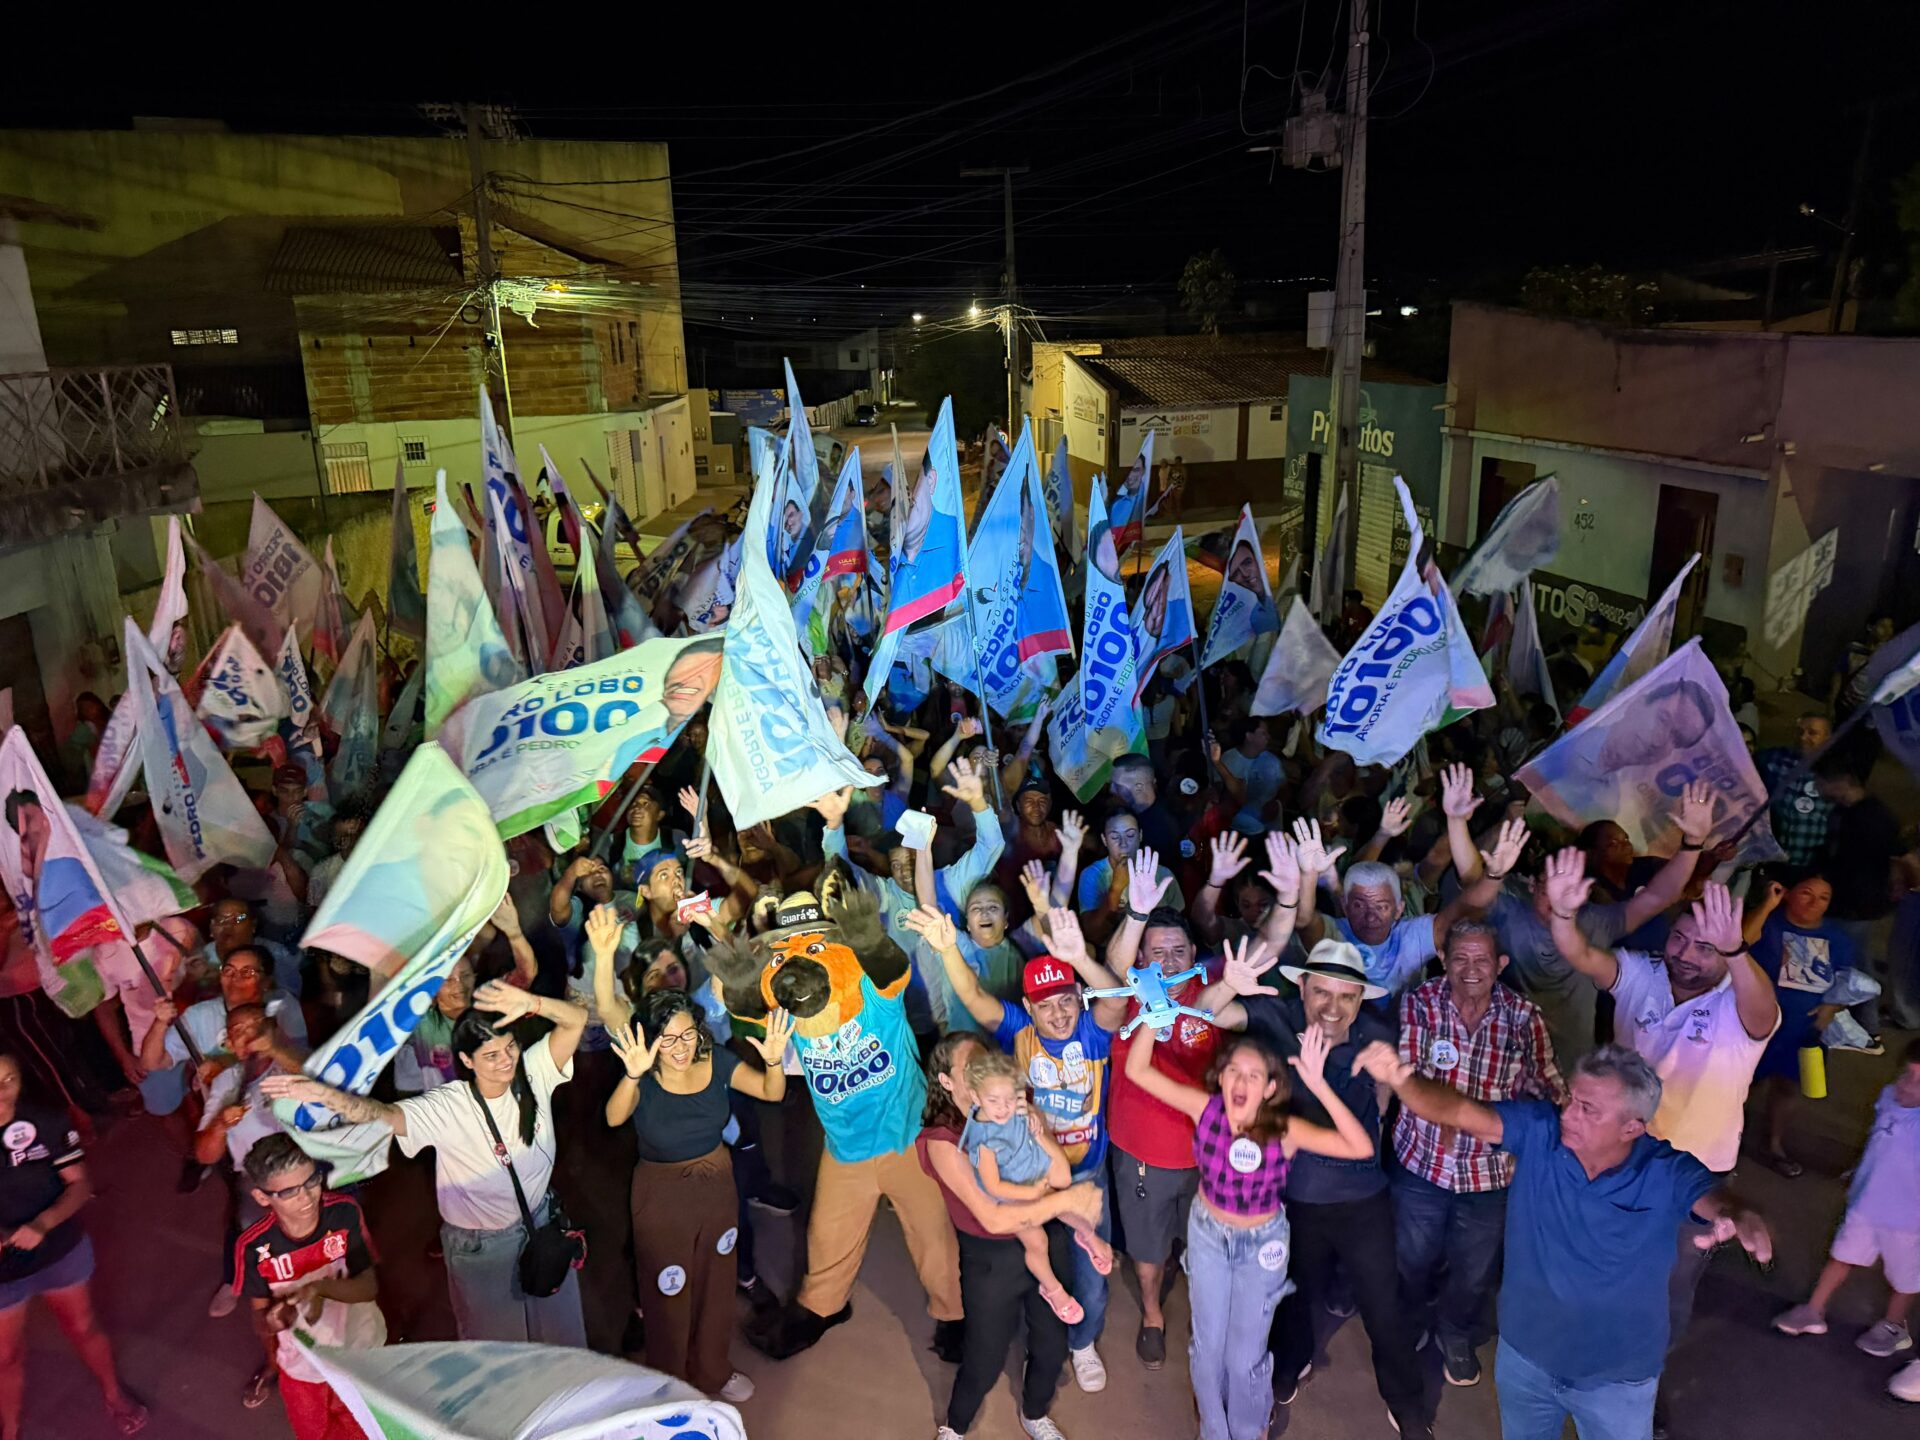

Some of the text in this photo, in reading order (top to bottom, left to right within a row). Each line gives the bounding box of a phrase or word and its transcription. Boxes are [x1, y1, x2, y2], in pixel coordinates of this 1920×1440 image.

[1574, 513, 1595, 530] 452
[1084, 590, 1113, 650] LOBO
[1326, 596, 1441, 739] 10100
[555, 675, 644, 703] LOBO
[1093, 698, 1118, 736] AGORA
[1354, 692, 1392, 743] AGORA
[781, 908, 806, 926] Guará
[1034, 968, 1065, 986] LULA
[1047, 1093, 1083, 1113] 1515
[270, 1253, 295, 1281] 10
